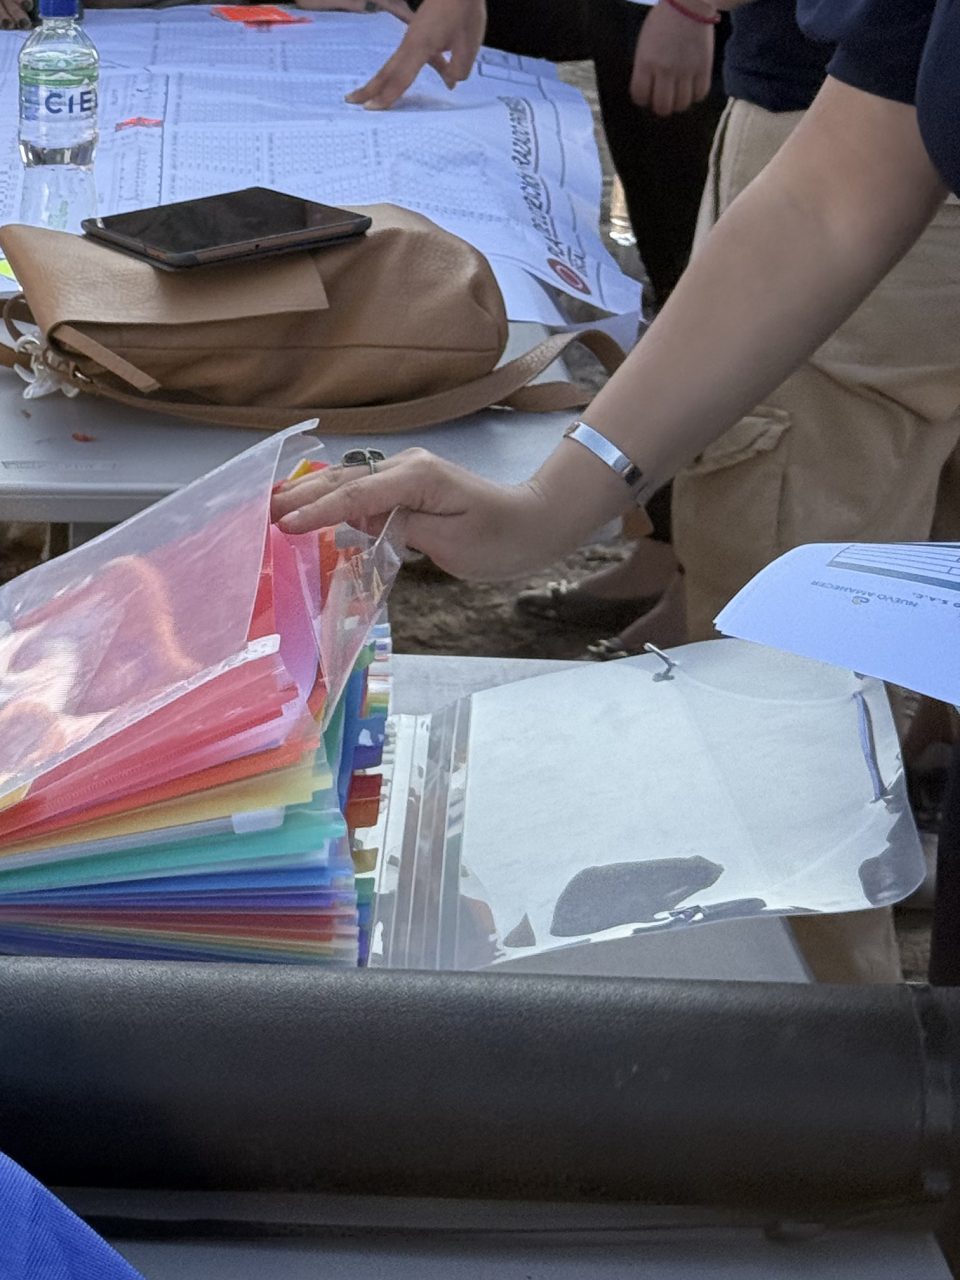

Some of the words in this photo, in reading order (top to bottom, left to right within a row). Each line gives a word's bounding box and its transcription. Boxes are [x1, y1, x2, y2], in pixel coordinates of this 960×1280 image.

[44, 91, 98, 115] CIE
[811, 580, 875, 598] AMANECER
[877, 593, 919, 607] NUEVO
